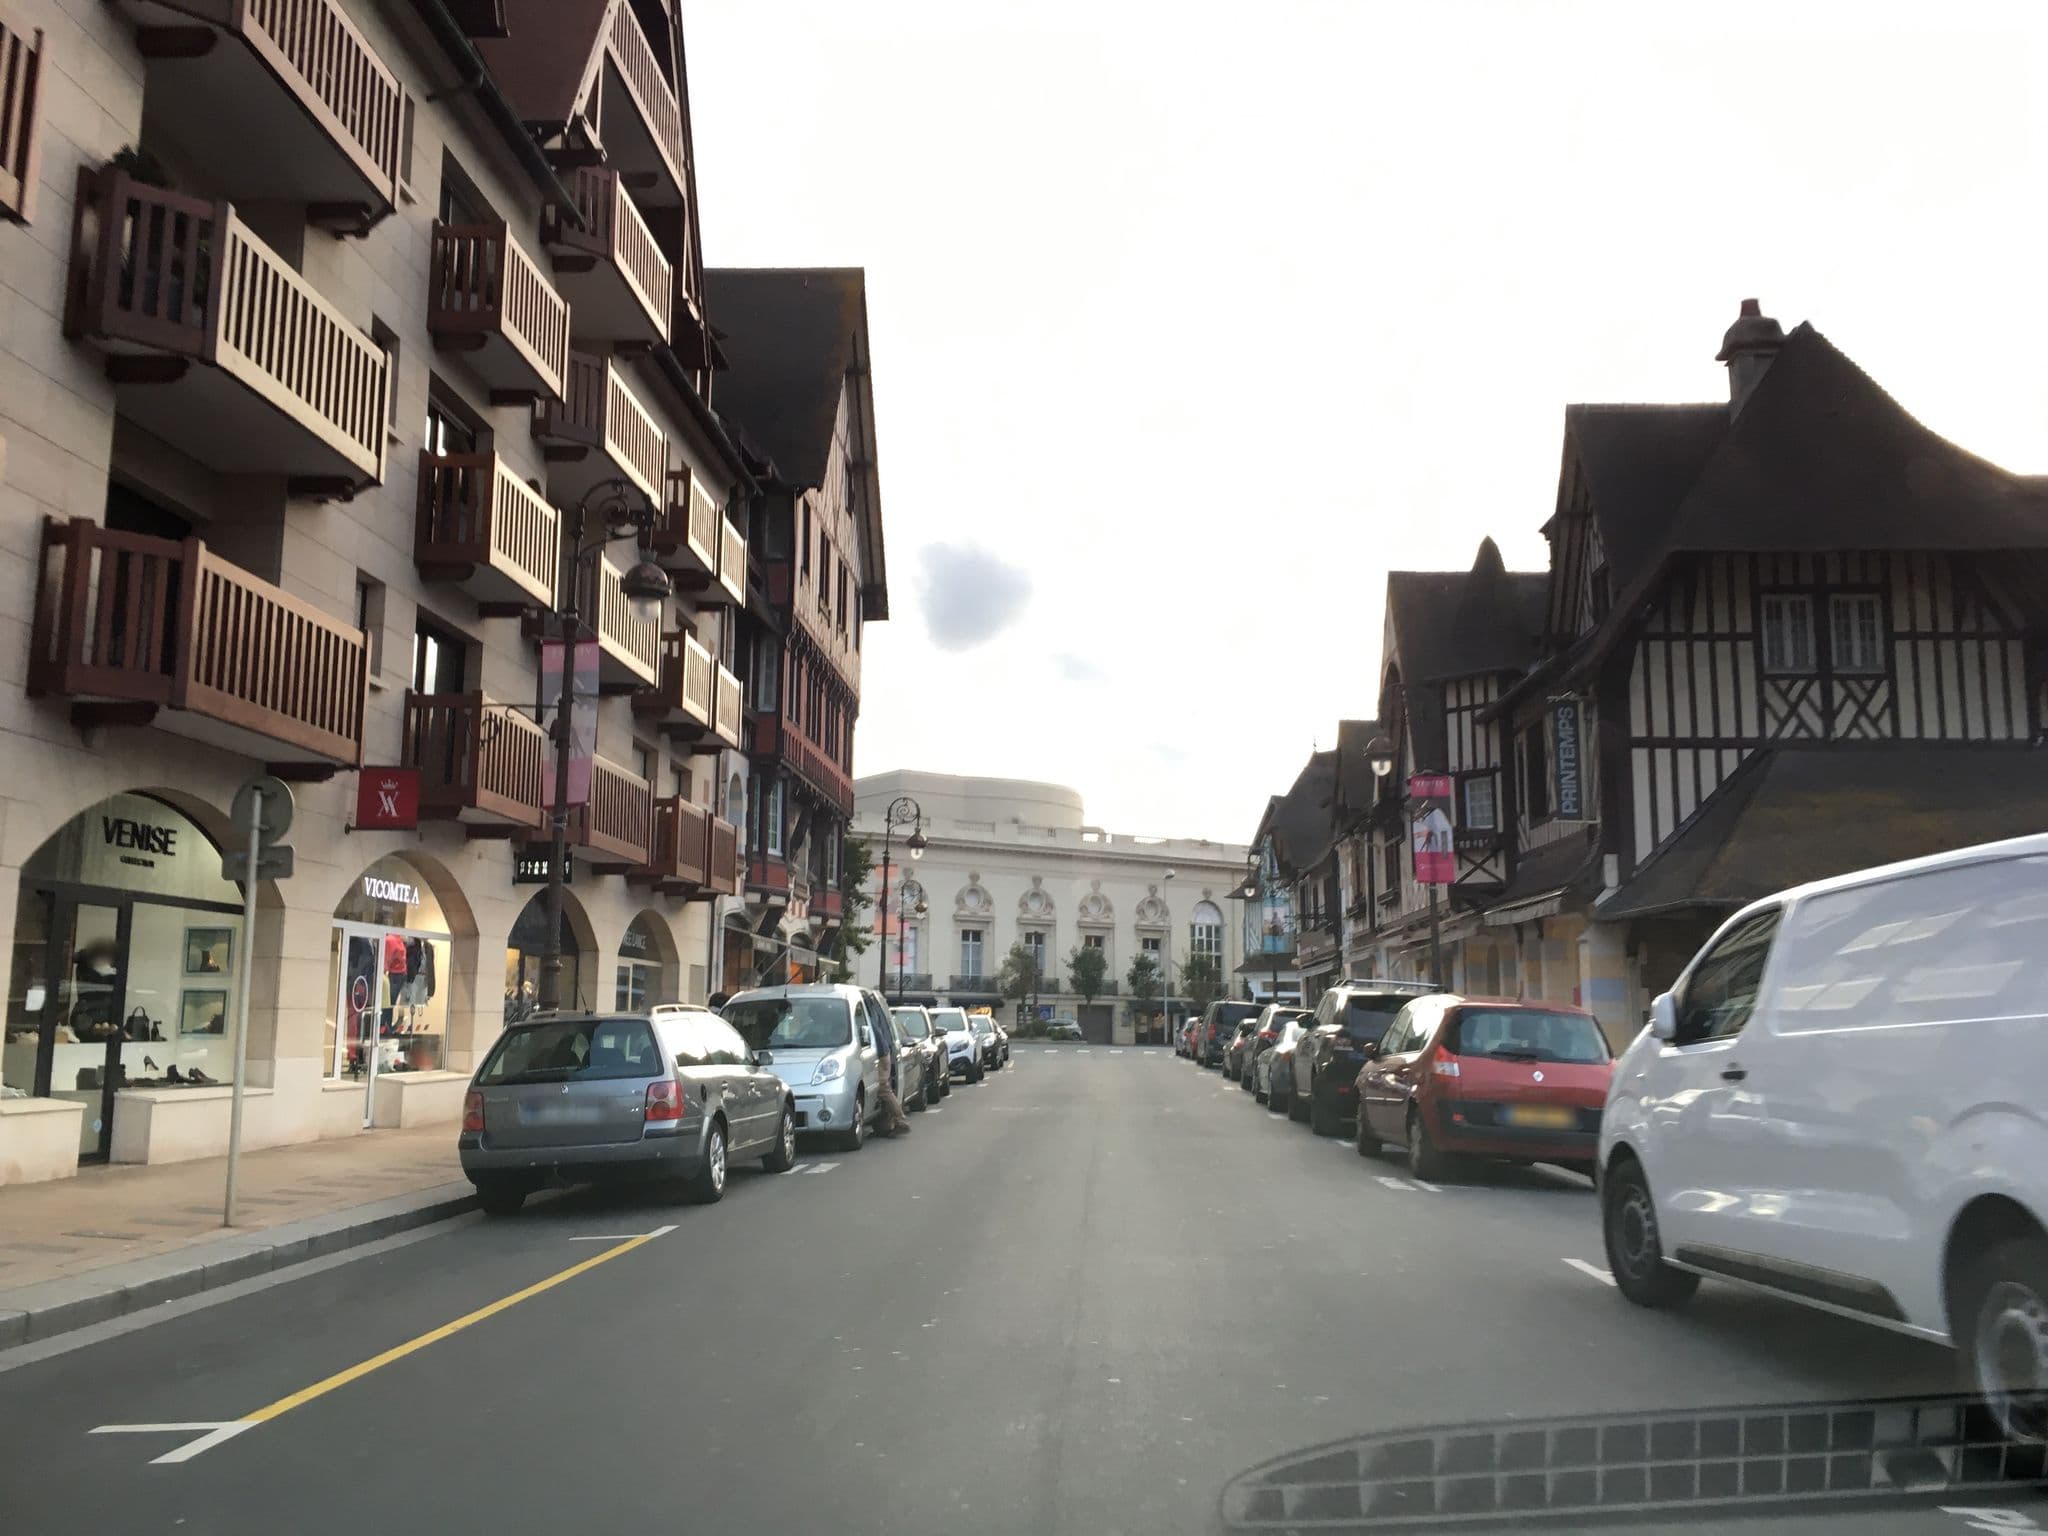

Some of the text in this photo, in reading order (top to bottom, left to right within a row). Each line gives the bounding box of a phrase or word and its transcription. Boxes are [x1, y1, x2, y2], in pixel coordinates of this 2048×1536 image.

[1557, 706, 1578, 814] PRINTEMPS
[103, 815, 178, 857] VENISE
[364, 876, 411, 904] VICOMTE
